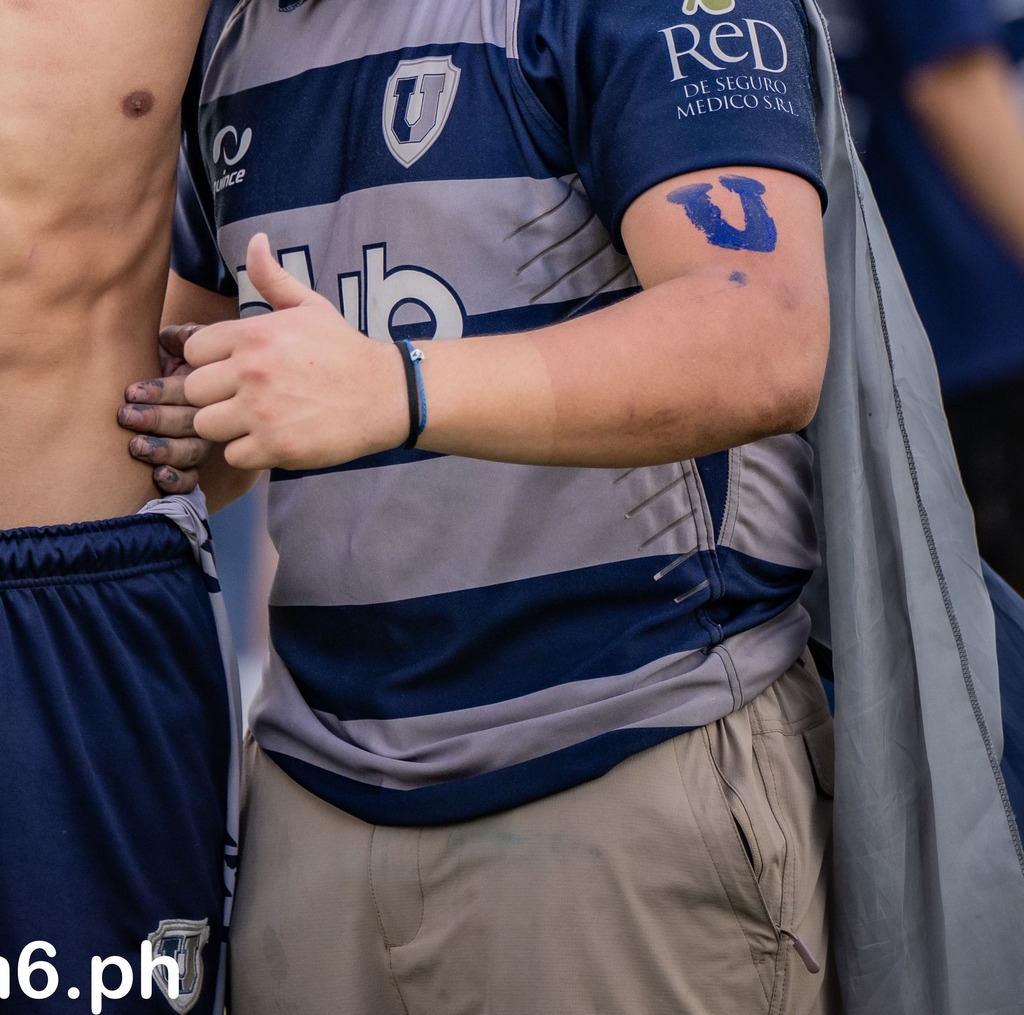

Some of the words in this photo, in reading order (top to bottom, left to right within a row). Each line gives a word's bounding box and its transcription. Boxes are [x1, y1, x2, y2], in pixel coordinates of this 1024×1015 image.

[683, 79, 711, 98] DE
[716, 75, 787, 95] SEGURO
[677, 94, 759, 120] MEDICO
